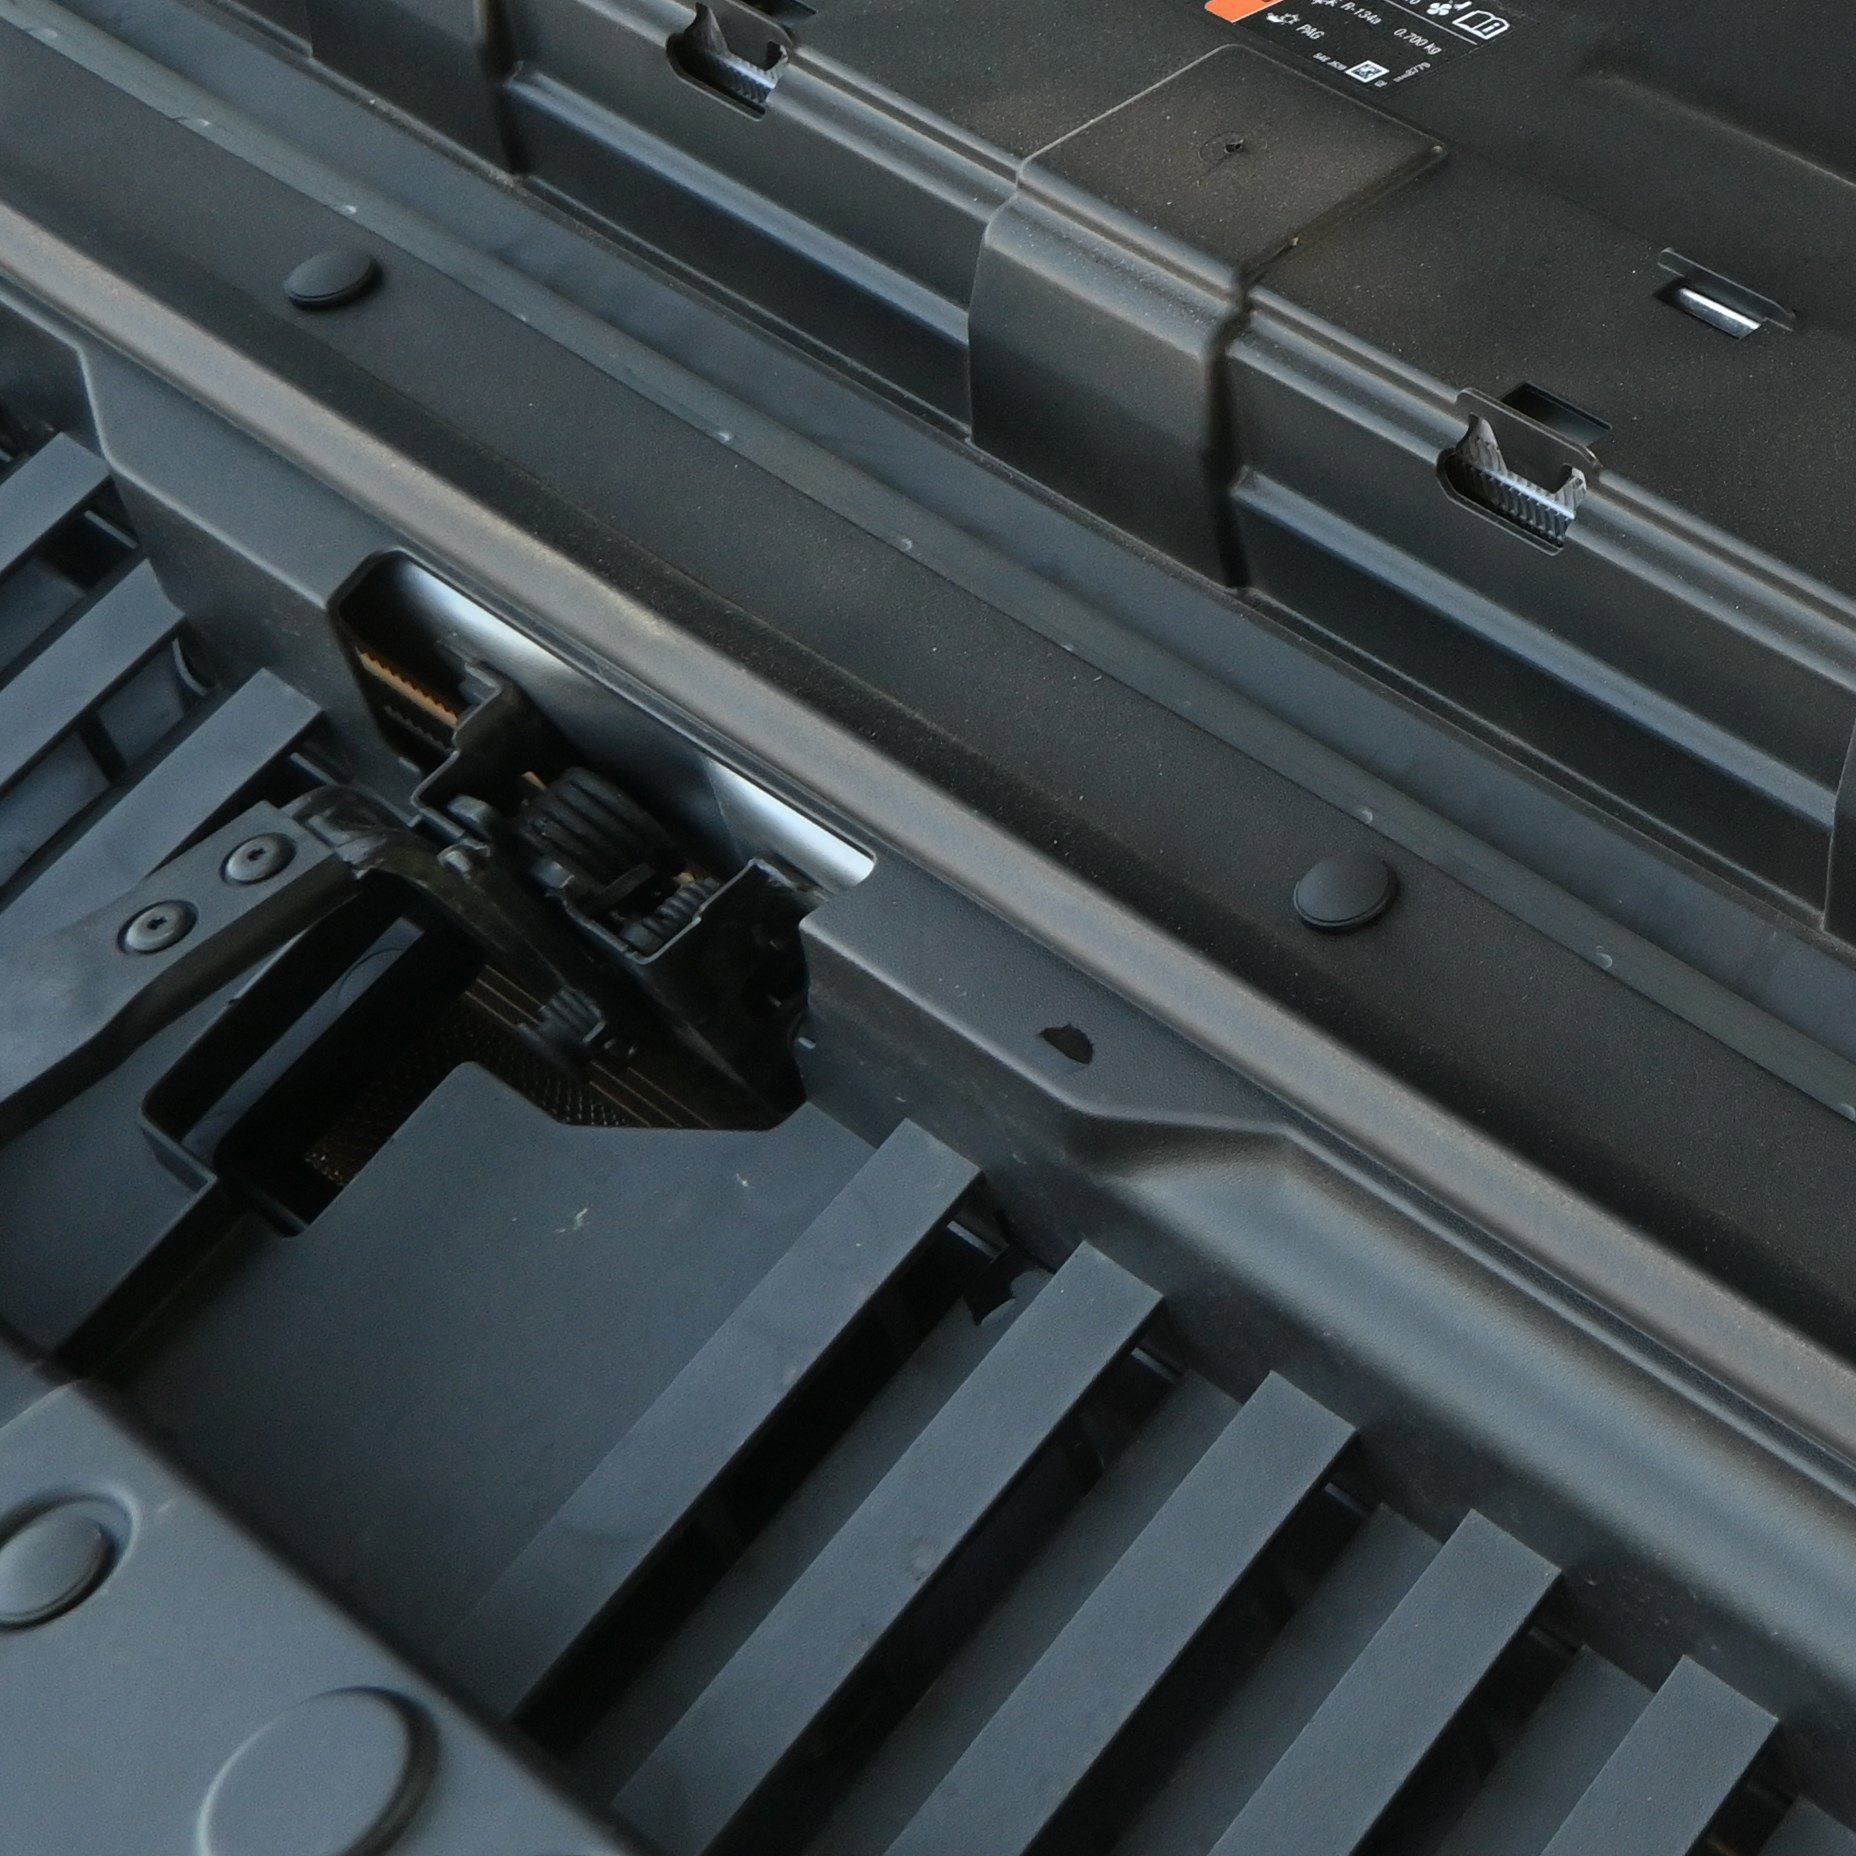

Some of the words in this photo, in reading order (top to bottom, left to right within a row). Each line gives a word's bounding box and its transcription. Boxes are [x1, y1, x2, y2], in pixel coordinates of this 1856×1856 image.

[1297, 24, 1325, 40] PAG
[1340, 2, 1382, 25] R-134a
[1394, 27, 1428, 48] 0.700
[1424, 41, 1443, 57] kg
